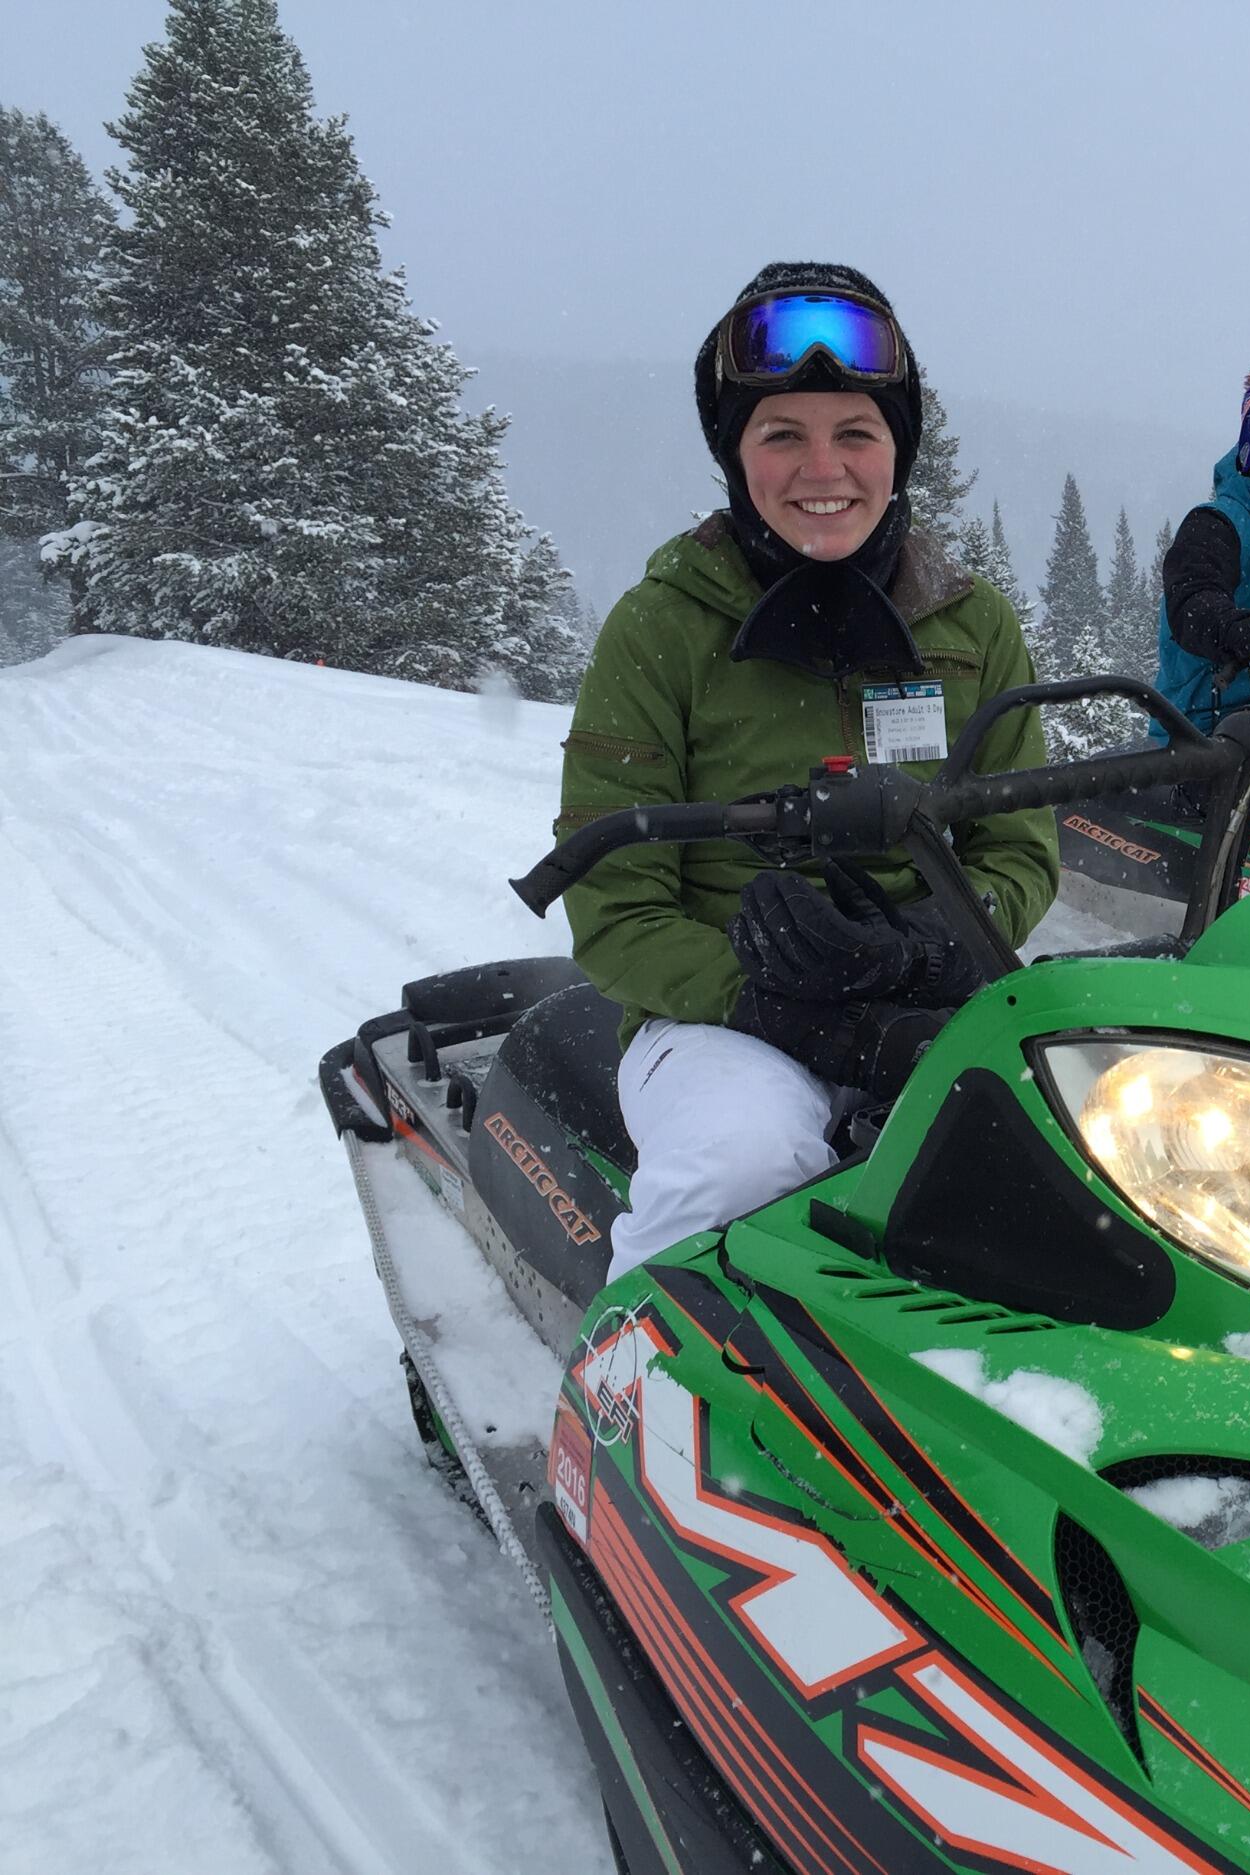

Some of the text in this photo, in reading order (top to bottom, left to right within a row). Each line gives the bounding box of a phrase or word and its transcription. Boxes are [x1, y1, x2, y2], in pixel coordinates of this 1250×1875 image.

[908, 703, 925, 715] Adult
[1064, 815, 1161, 864] ARCTIC CAT
[484, 1111, 601, 1246] ARCTIC CAT
[597, 1375, 634, 1446] EFI
[557, 1447, 585, 1507] 2016
